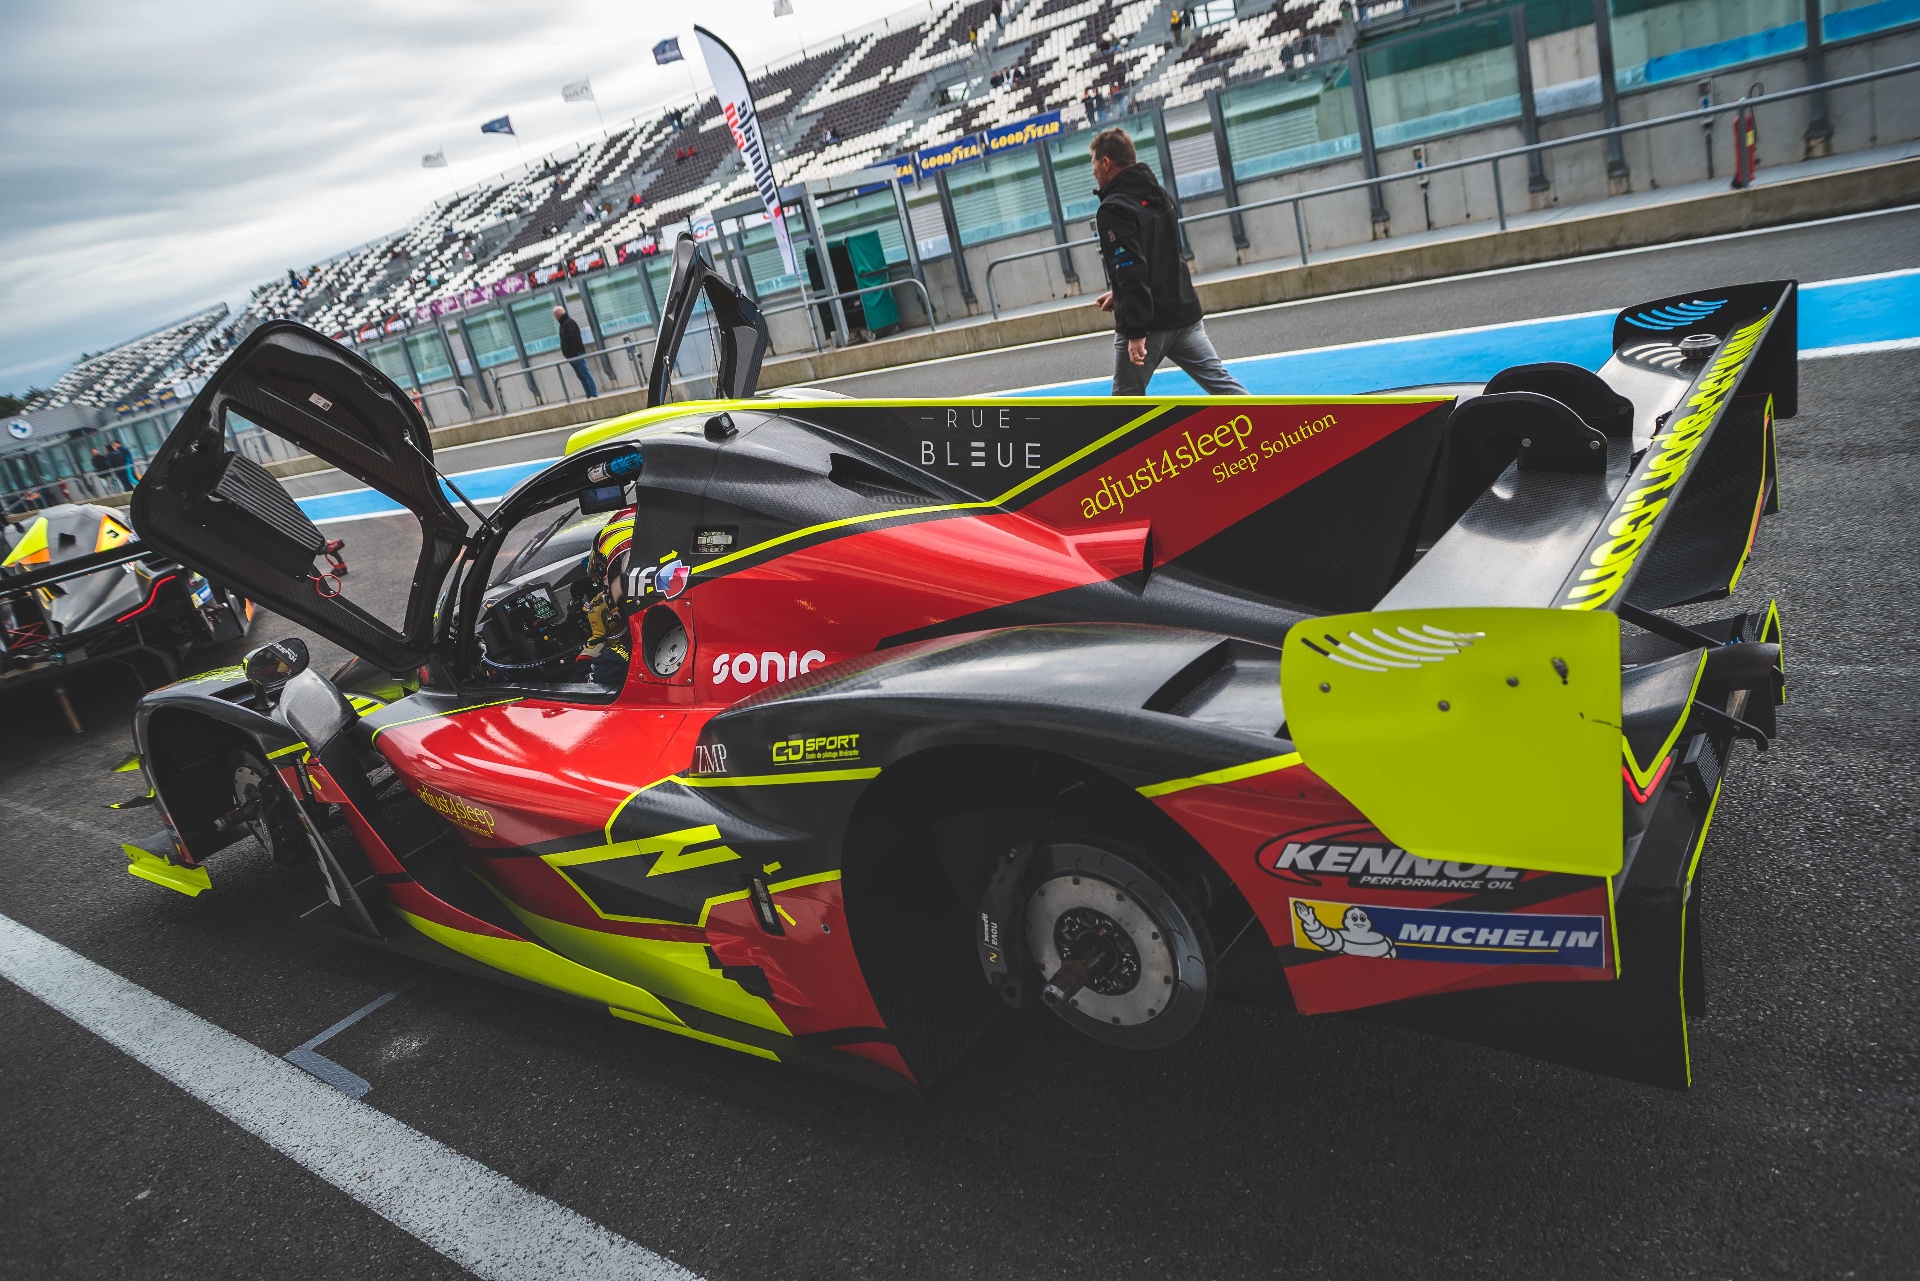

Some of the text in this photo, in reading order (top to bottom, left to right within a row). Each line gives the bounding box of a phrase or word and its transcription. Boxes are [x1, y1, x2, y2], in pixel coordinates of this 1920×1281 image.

[990, 120, 1060, 150] GOODYEAR
[947, 408, 1010, 429] RUE
[921, 440, 1042, 470] BLEUE
[1211, 410, 1338, 485] Sleep Solution
[1080, 411, 1255, 520] adjust4sleep
[806, 733, 860, 751] SPORT
[695, 743, 728, 774] ZMP
[1359, 875, 1515, 890] PERFORMANCE OIL
[1398, 922, 1600, 949] MICHELIN
